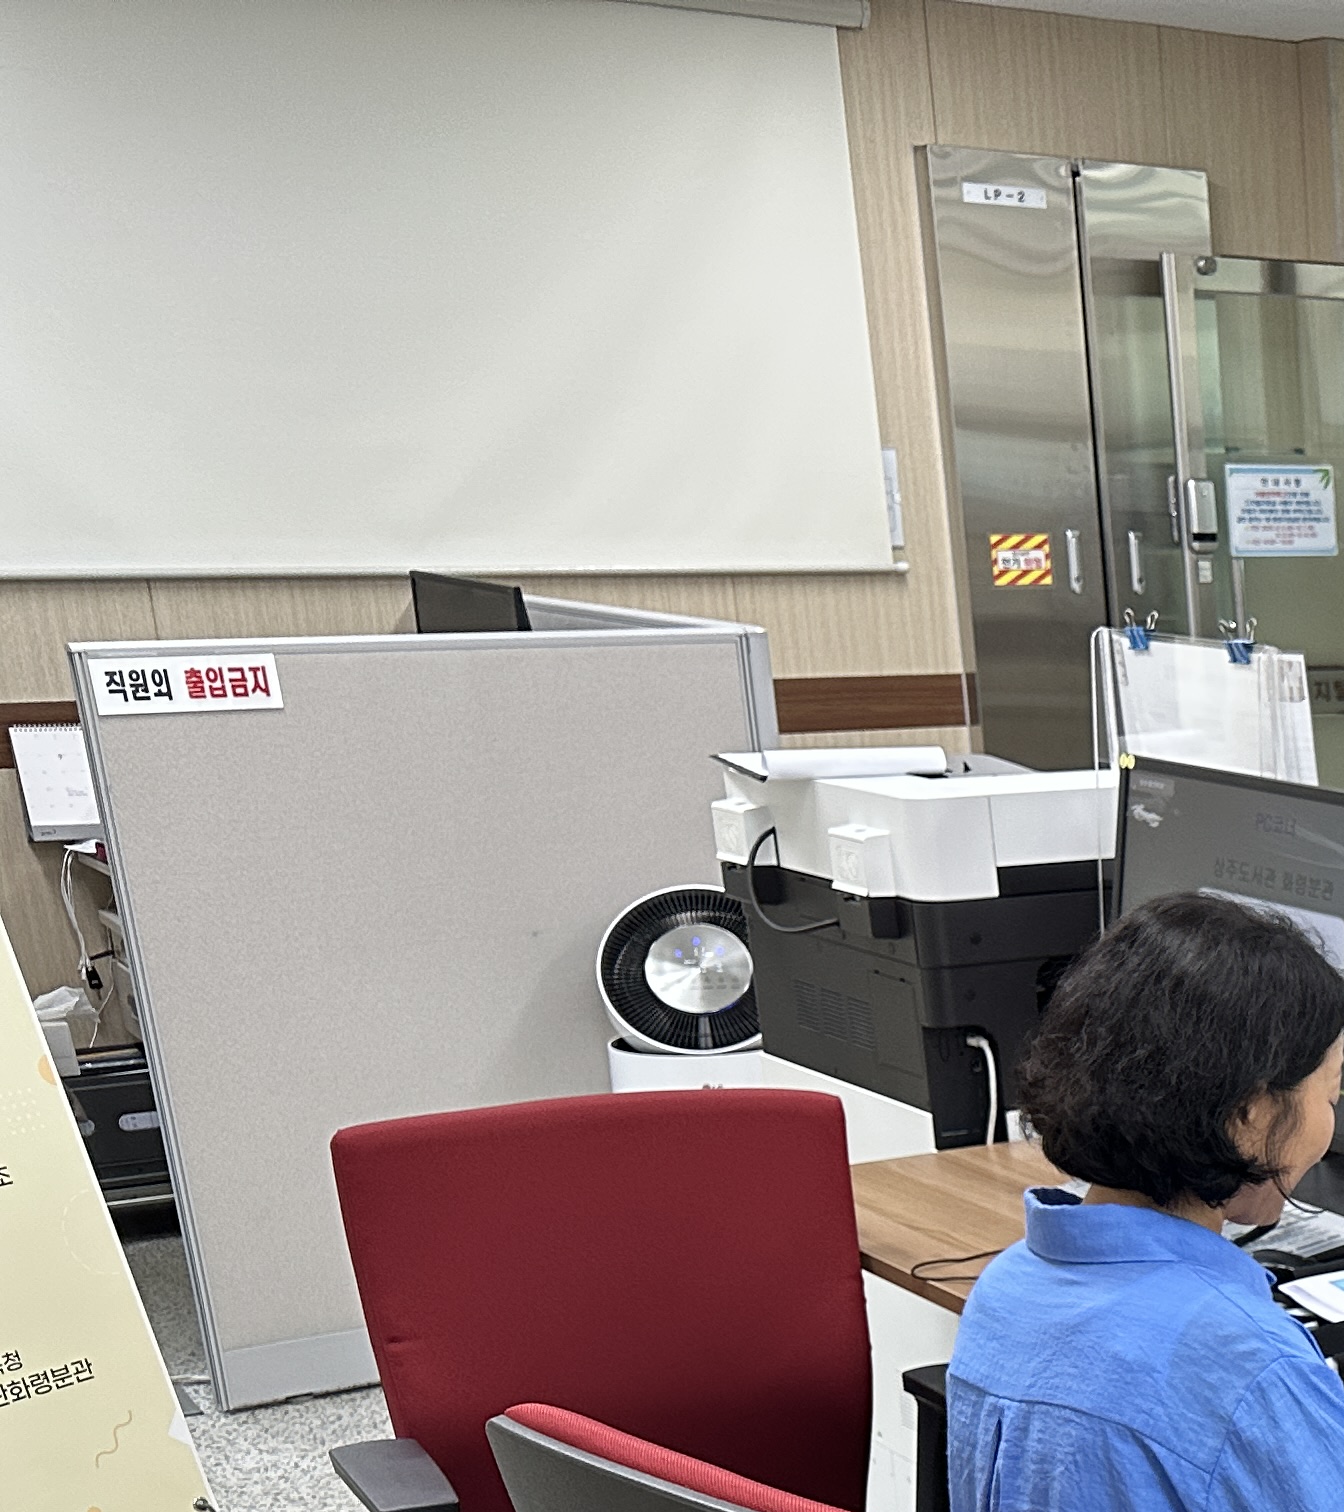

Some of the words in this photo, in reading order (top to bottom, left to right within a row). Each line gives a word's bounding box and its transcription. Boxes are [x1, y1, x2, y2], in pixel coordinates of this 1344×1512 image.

[103, 668, 174, 702] 직원외
[184, 665, 271, 699] 출입금지
[1255, 812, 1298, 837] PC코너
[1214, 857, 1276, 889] 상주도서관
[1281, 872, 1335, 900] 화령분관
